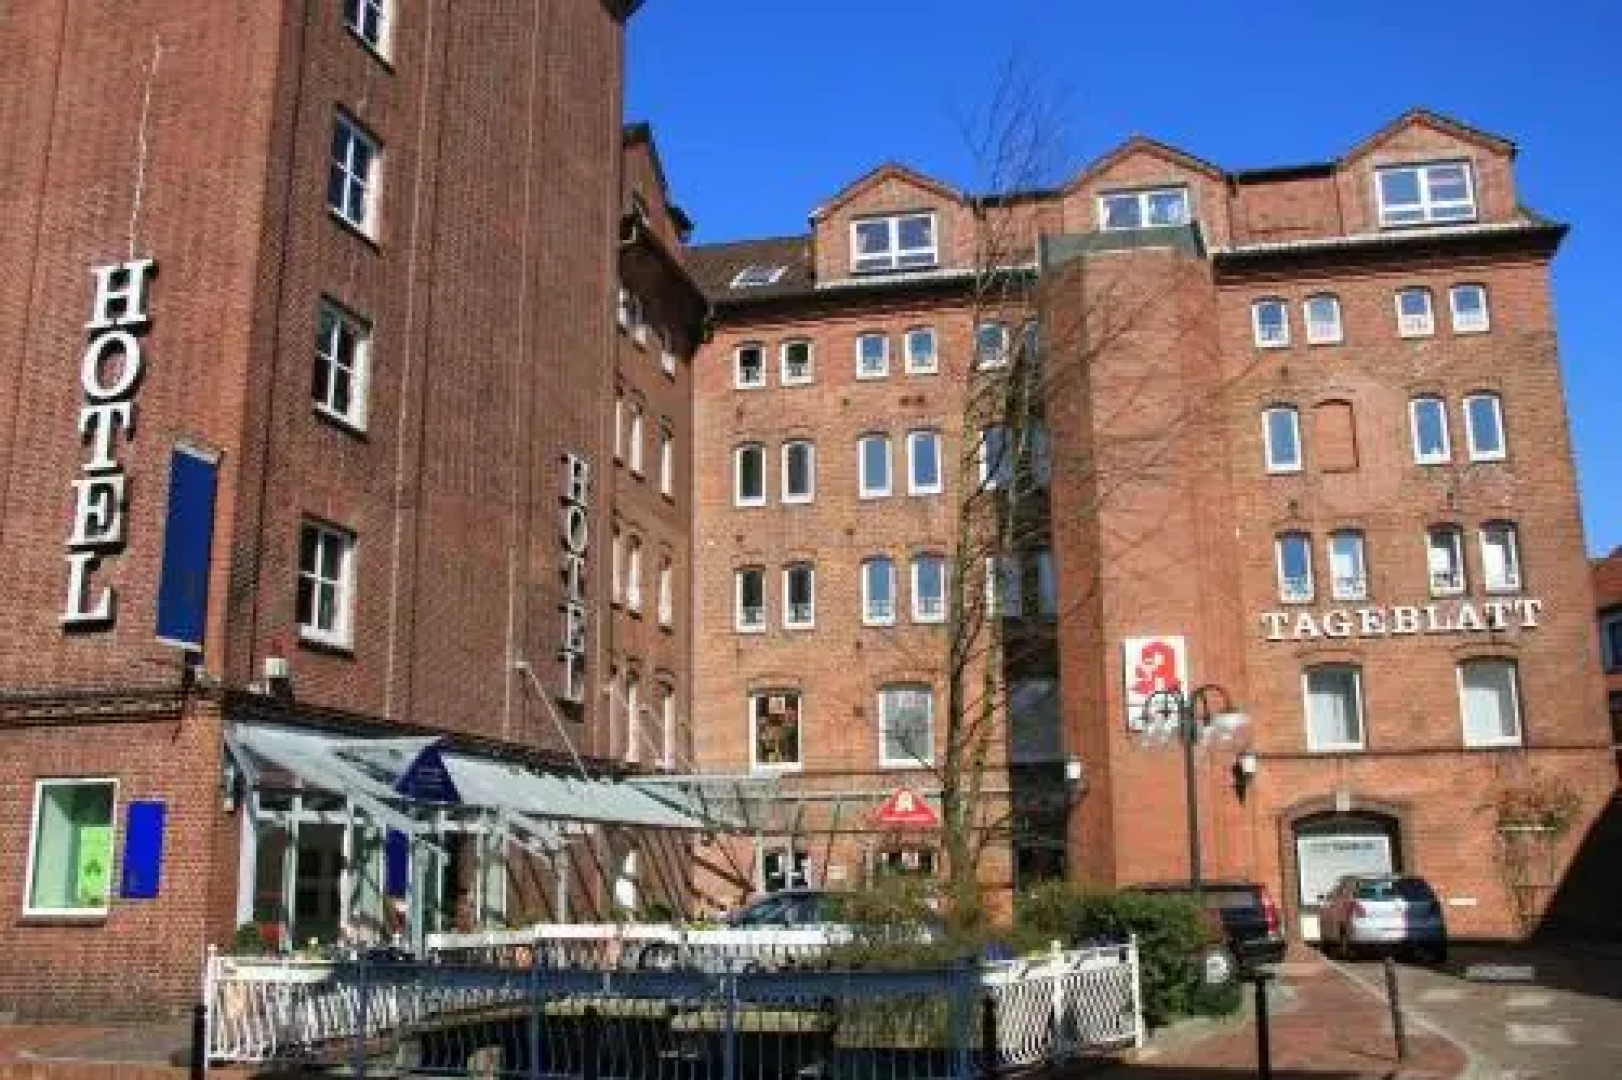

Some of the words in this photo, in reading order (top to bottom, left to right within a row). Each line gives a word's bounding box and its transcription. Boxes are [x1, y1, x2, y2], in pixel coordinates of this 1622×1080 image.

[59, 258, 156, 625] HOTEL
[563, 453, 588, 702] HOTEL
[1260, 599, 1542, 640] TAGEBLATT
